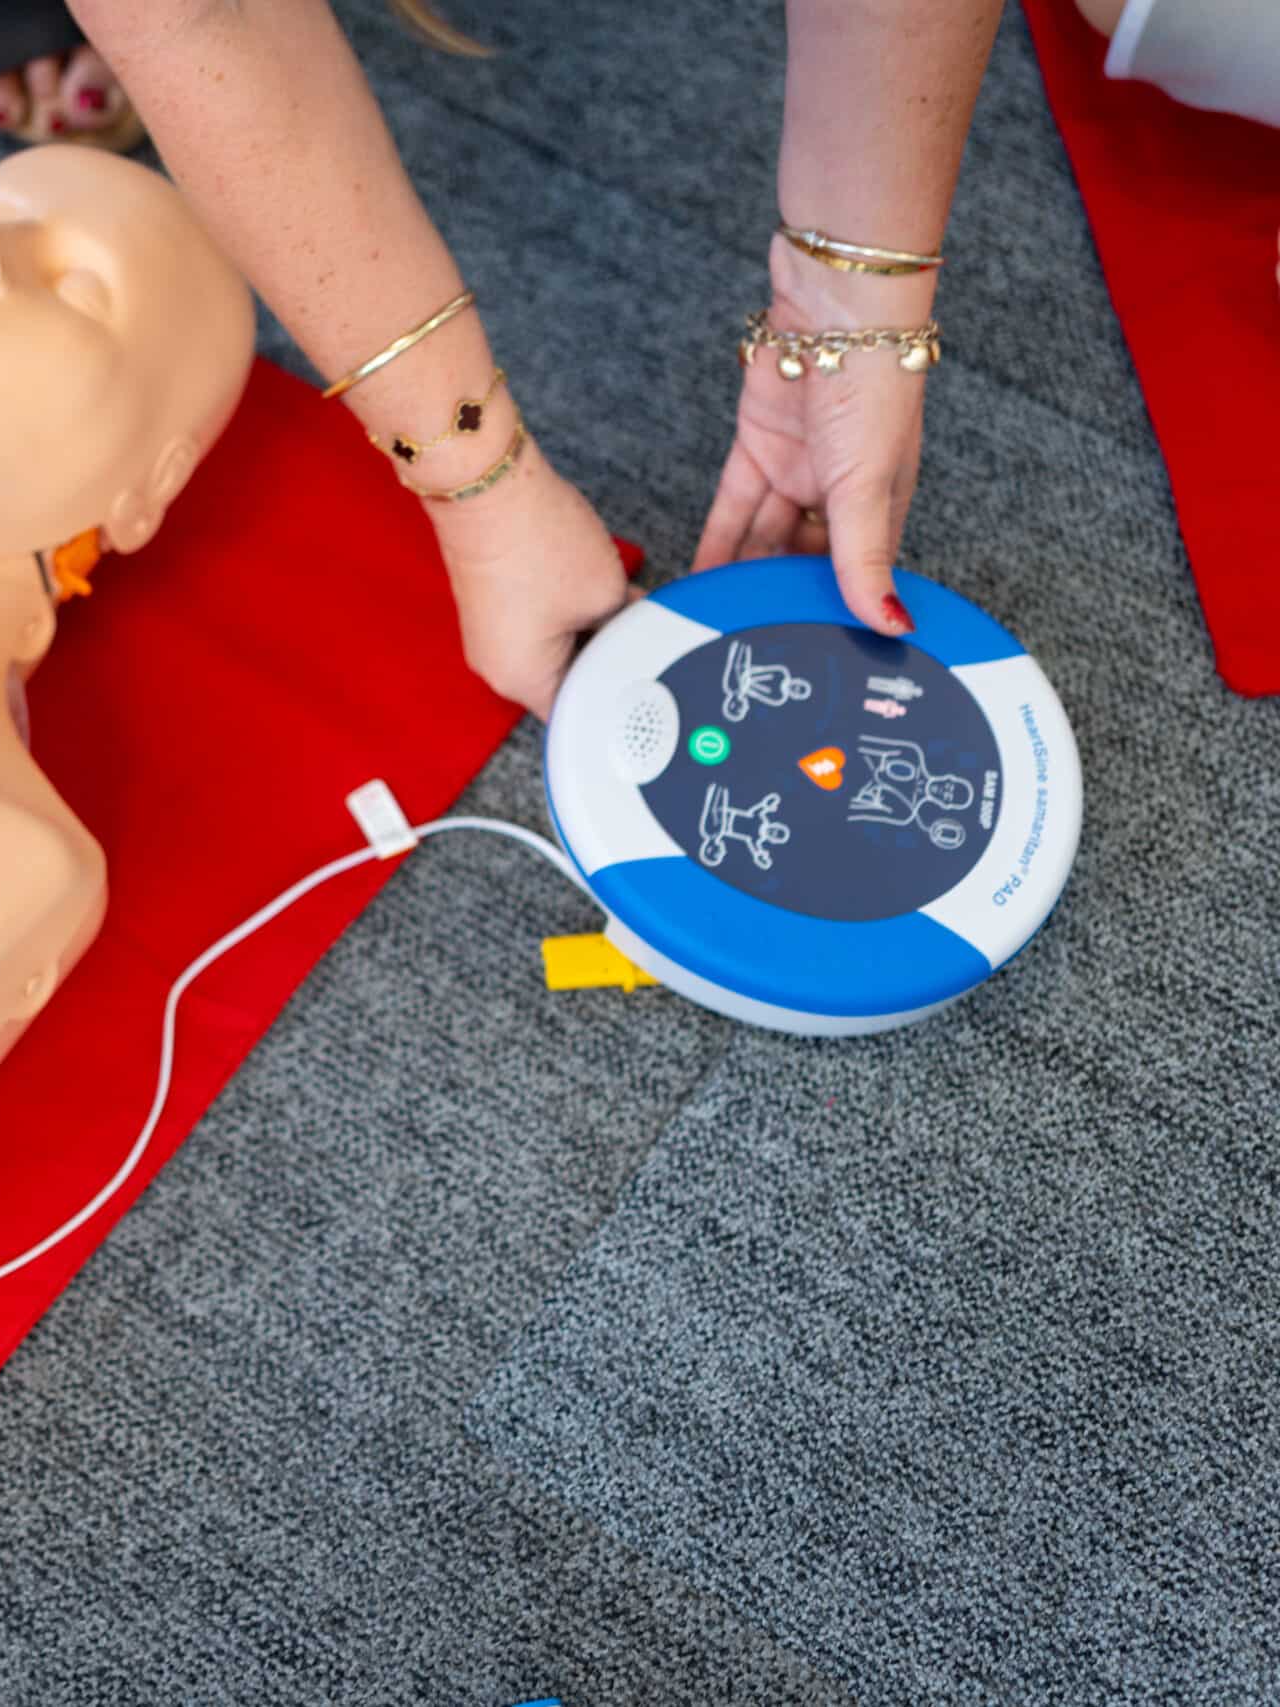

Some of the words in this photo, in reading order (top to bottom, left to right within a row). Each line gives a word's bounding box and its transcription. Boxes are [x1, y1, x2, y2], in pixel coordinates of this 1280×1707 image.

[1019, 704, 1049, 783] HeartSine
[983, 770, 999, 799] SAM
[992, 873, 1022, 906] PAD
